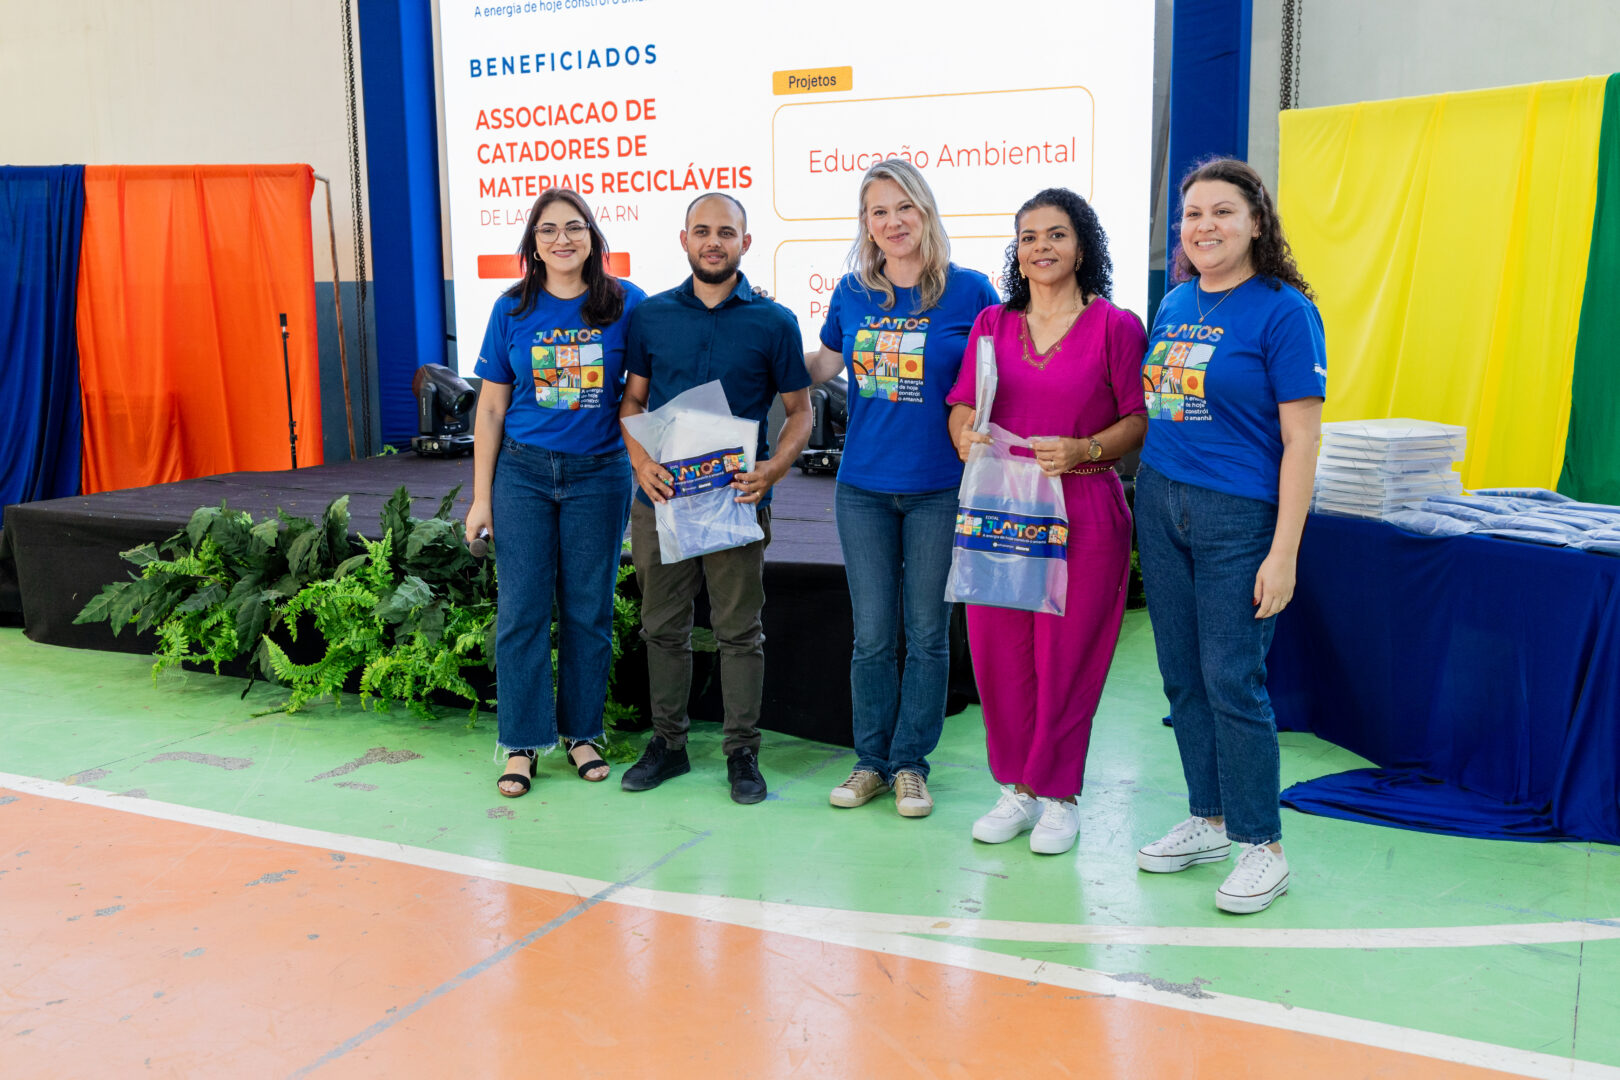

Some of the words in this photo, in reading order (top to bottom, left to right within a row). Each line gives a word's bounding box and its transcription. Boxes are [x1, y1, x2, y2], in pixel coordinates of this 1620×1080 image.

[474, 5, 482, 18] A
[484, 3, 522, 18] energia
[524, 1, 537, 14] de
[469, 44, 657, 78] BENEFICIADOS
[788, 73, 837, 91] Projetos
[475, 100, 618, 130] ASSOCIACAO
[626, 98, 657, 122] DE
[477, 136, 609, 164] CATADORES
[617, 135, 647, 157] DE
[936, 137, 1076, 168] Ambiental
[601, 163, 753, 194] RECICLÁVEIS
[480, 209, 502, 226] DE
[616, 205, 638, 222] RN
[860, 316, 930, 330] JUNTOS
[1161, 323, 1224, 342] JUNTOS
[532, 328, 602, 344] JUNTOS
[984, 520, 1047, 540] JUNTOS
